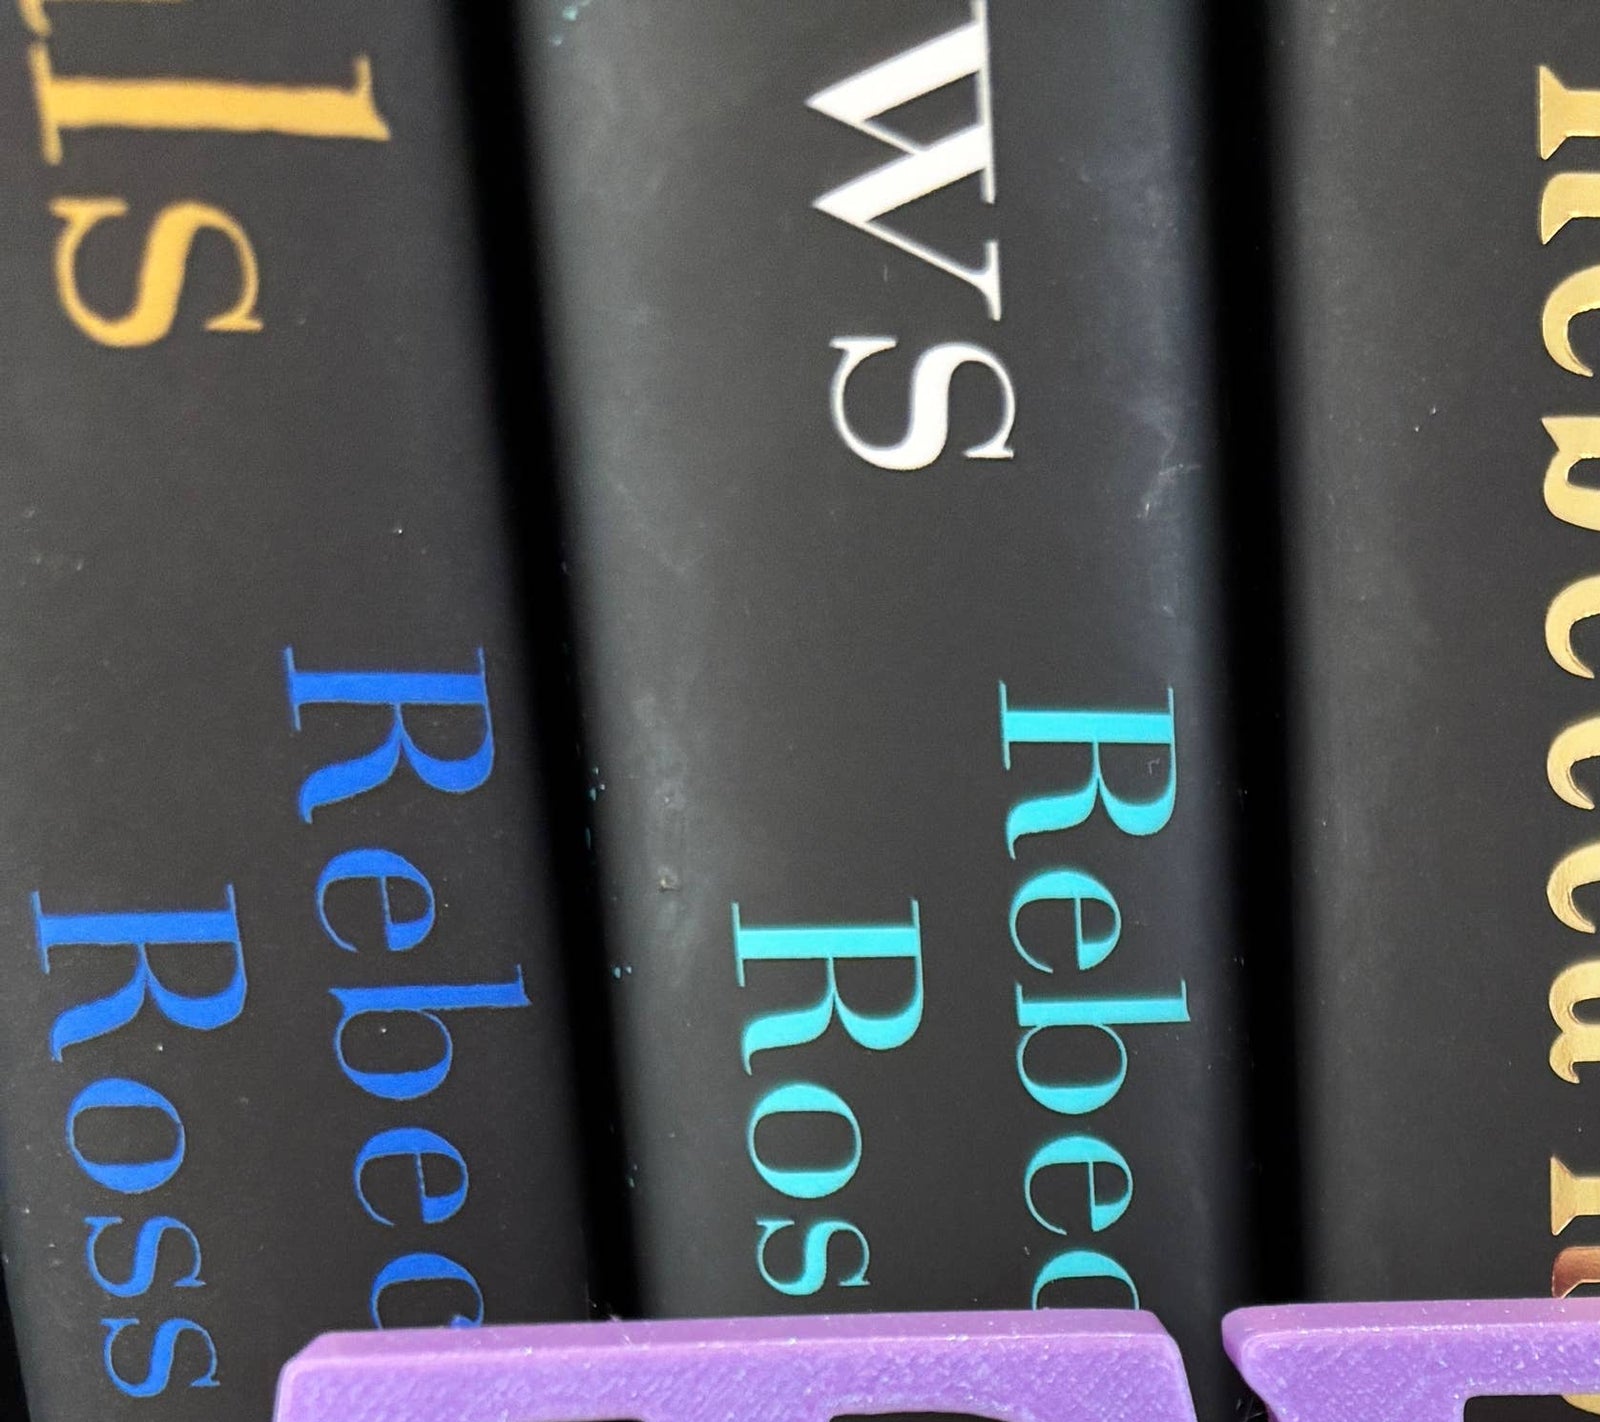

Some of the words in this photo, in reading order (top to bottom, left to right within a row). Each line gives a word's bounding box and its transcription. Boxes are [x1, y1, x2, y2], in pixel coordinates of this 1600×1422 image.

[18, 0, 391, 347] ls
[30, 882, 247, 1397] Ross
[730, 898, 924, 1296] Ros
